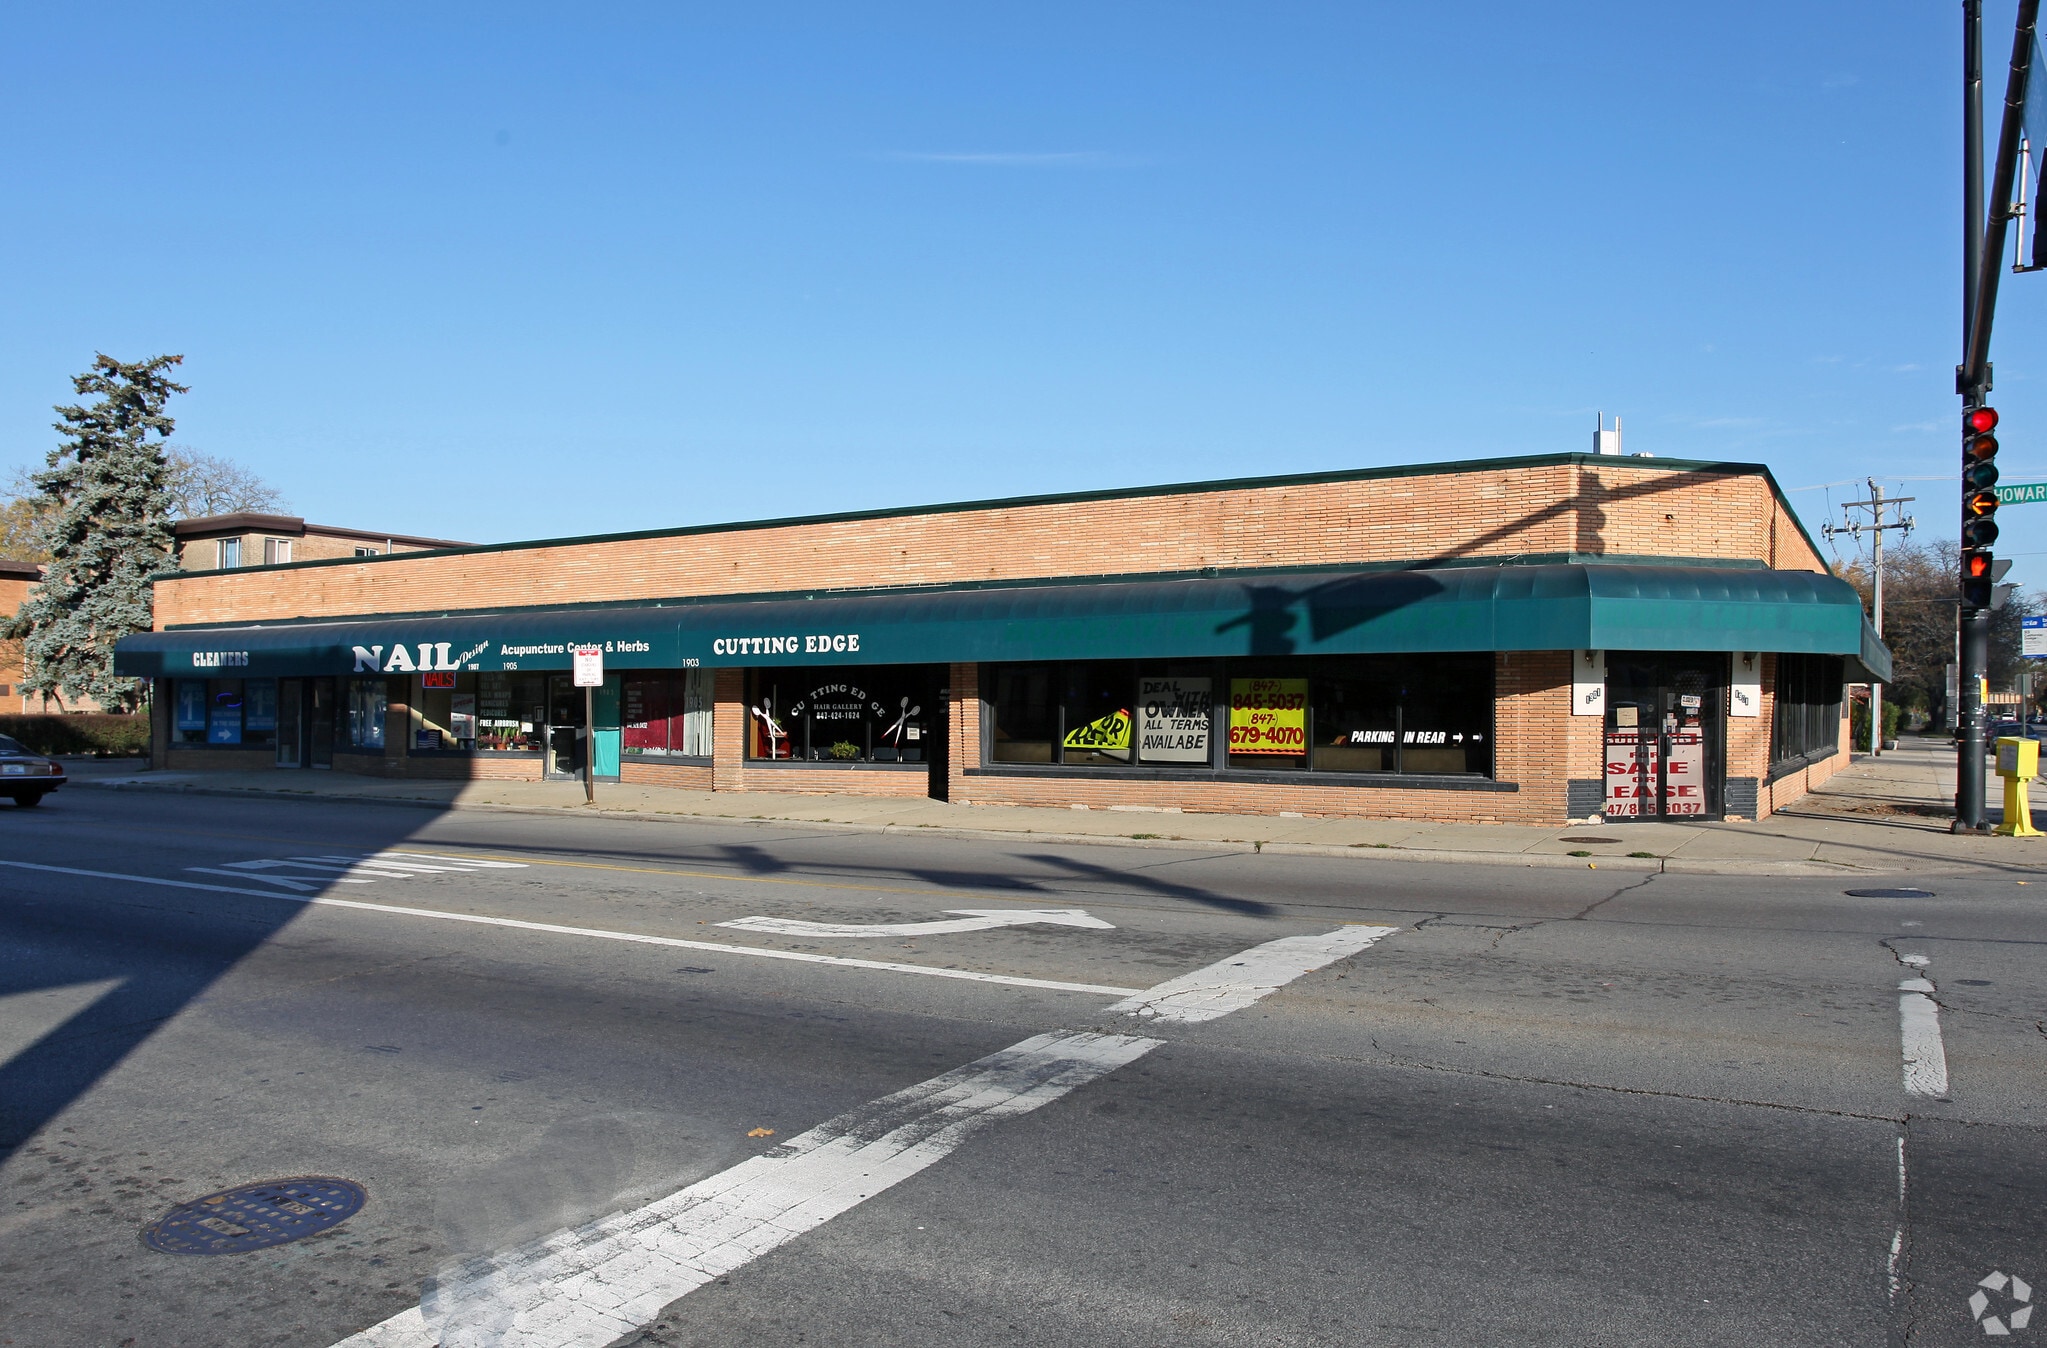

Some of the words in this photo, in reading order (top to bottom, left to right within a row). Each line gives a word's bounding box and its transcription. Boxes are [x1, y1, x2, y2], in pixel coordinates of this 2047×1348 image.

[1993, 485, 2047, 502] HOWAR
[500, 643, 564, 657] Acupuncture
[605, 640, 613, 652] &
[617, 640, 650, 652] Herbs
[713, 636, 799, 655] CUTTING
[805, 634, 860, 653] EDGE
[193, 651, 249, 667] CLEANERS
[352, 642, 460, 672] NAIL
[460, 640, 489, 664] Design
[682, 658, 700, 667] 1903
[502, 662, 518, 670] 1905
[424, 672, 455, 687] NAILS
[1249, 680, 1282, 693] (847-)
[1143, 681, 1181, 694] DEAL
[686, 697, 703, 708] 1905
[1175, 691, 1211, 702] WITH
[1233, 693, 1305, 711] 845-5037
[1145, 701, 1210, 719] OWNER
[479, 719, 492, 727] FREE
[494, 719, 519, 728] AIRBRUSH
[1144, 719, 1163, 730] ALL
[1171, 719, 1209, 731] TERMS
[1247, 712, 1279, 727] (847-)
[1141, 734, 1206, 750] AVAILABE
[1229, 726, 1304, 745] 679-4070
[1351, 731, 1395, 743] PARKING
[1403, 731, 1414, 743] IN
[1416, 731, 1446, 744] REAR
[1606, 785, 1698, 798] EASE
